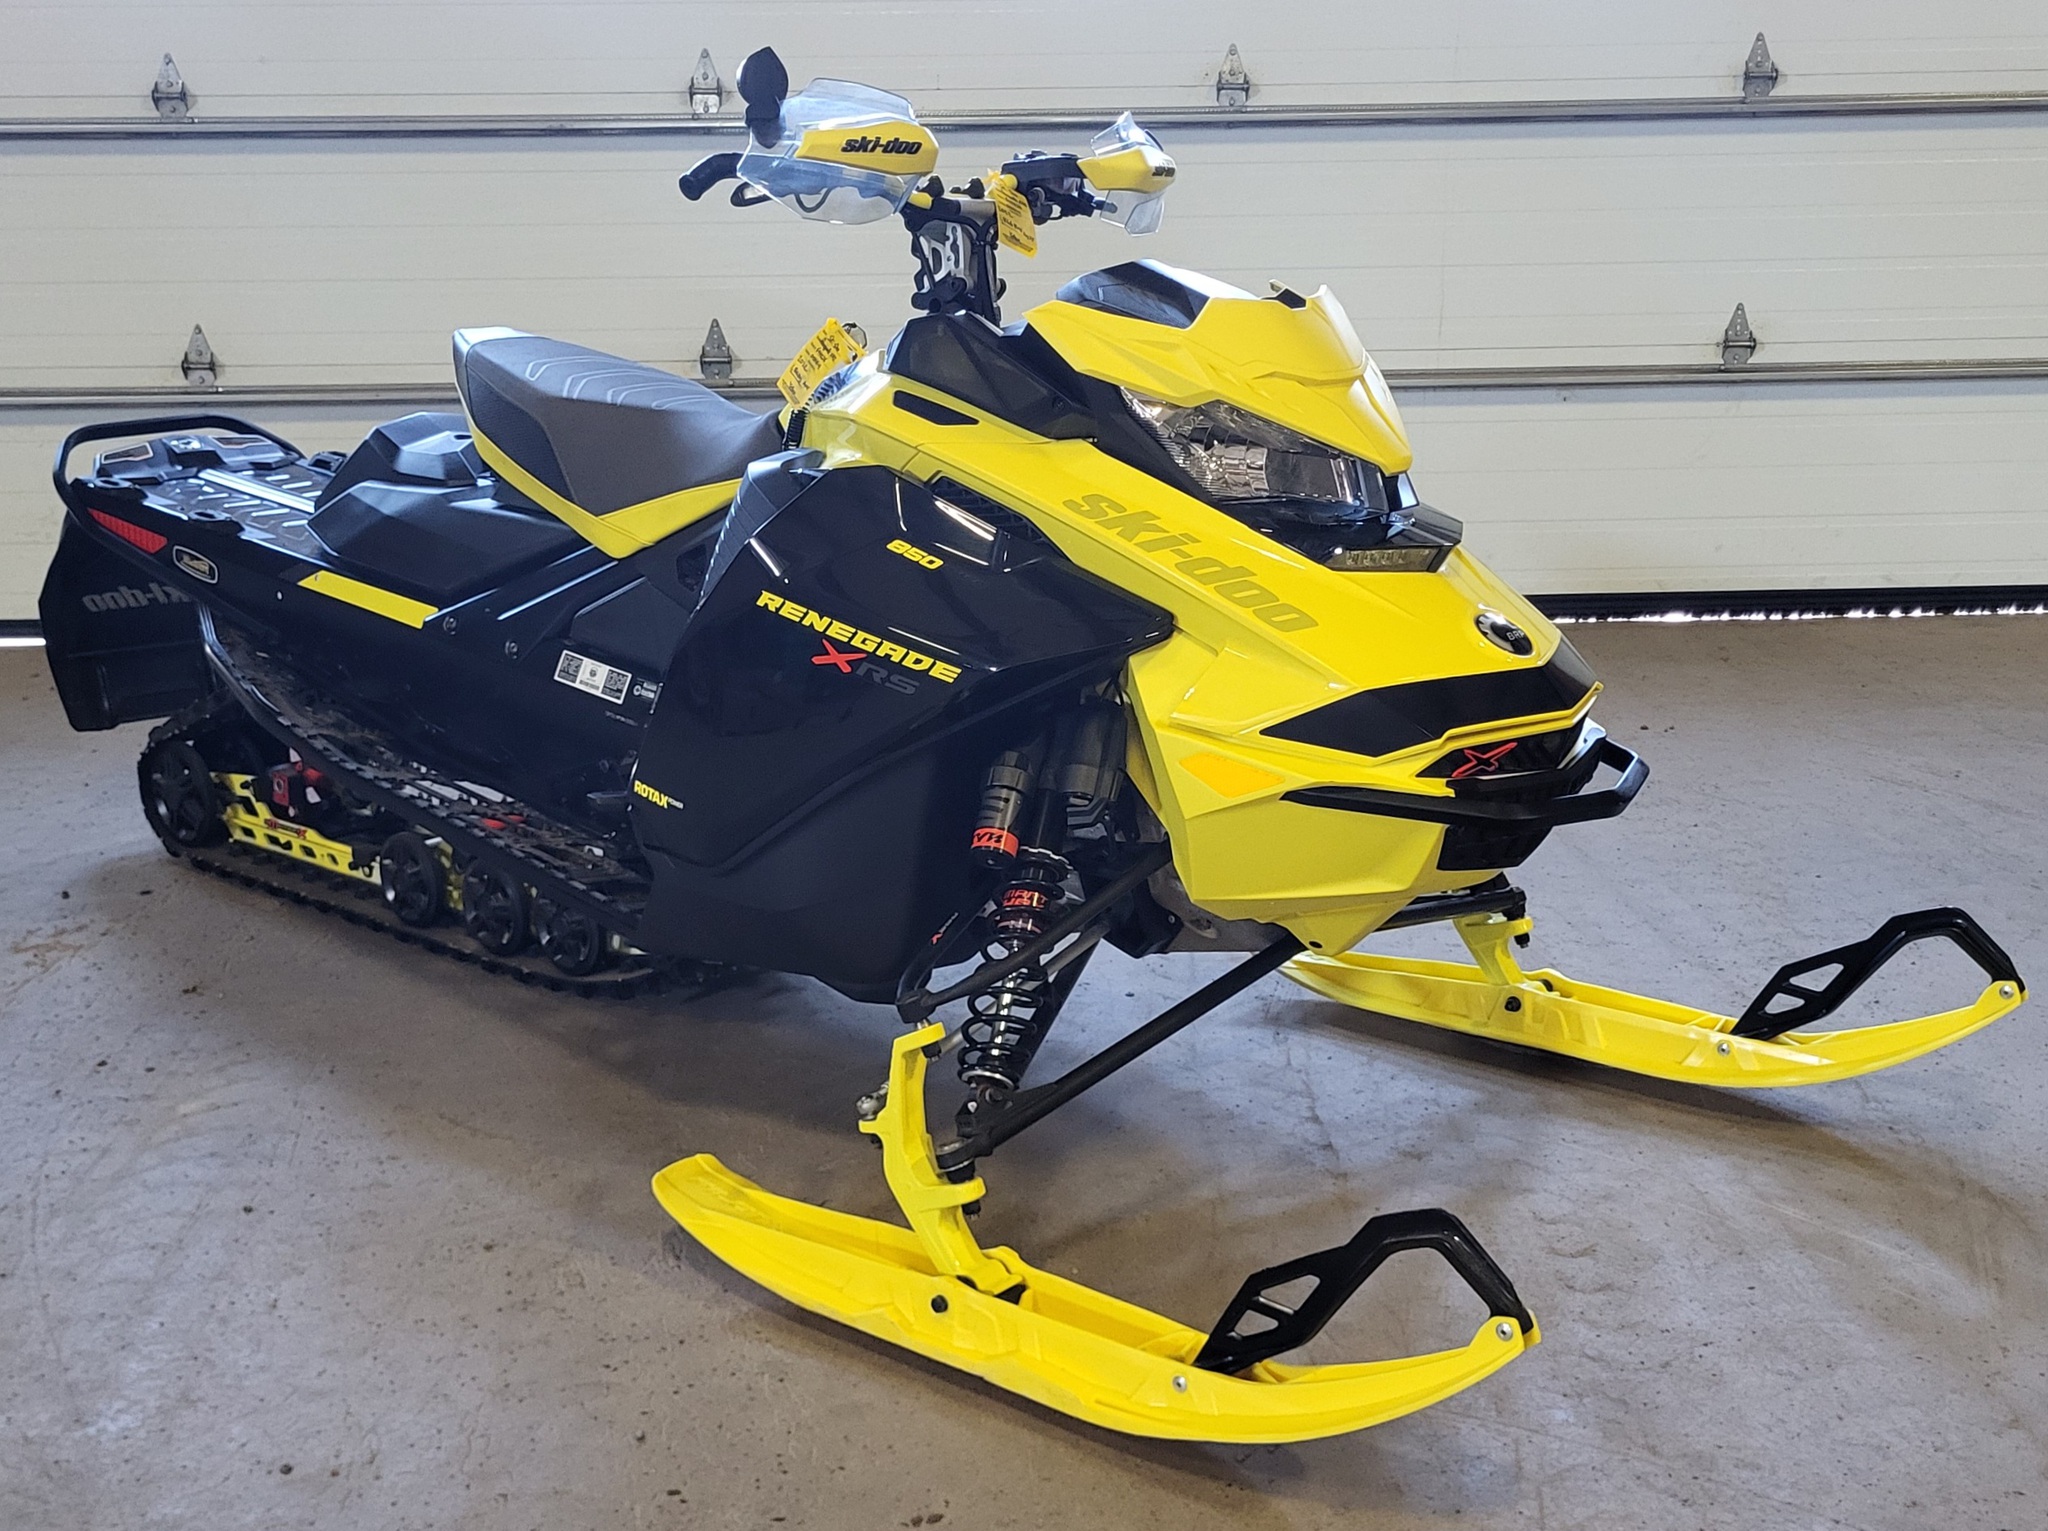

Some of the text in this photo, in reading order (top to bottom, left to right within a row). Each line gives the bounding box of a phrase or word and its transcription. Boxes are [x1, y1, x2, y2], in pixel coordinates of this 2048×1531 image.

[841, 136, 923, 155] ski-doo
[886, 538, 944, 570] 850
[1063, 493, 1320, 633] ski-doo
[756, 589, 963, 684] RENEGADE
[633, 779, 669, 809] ROTAX
